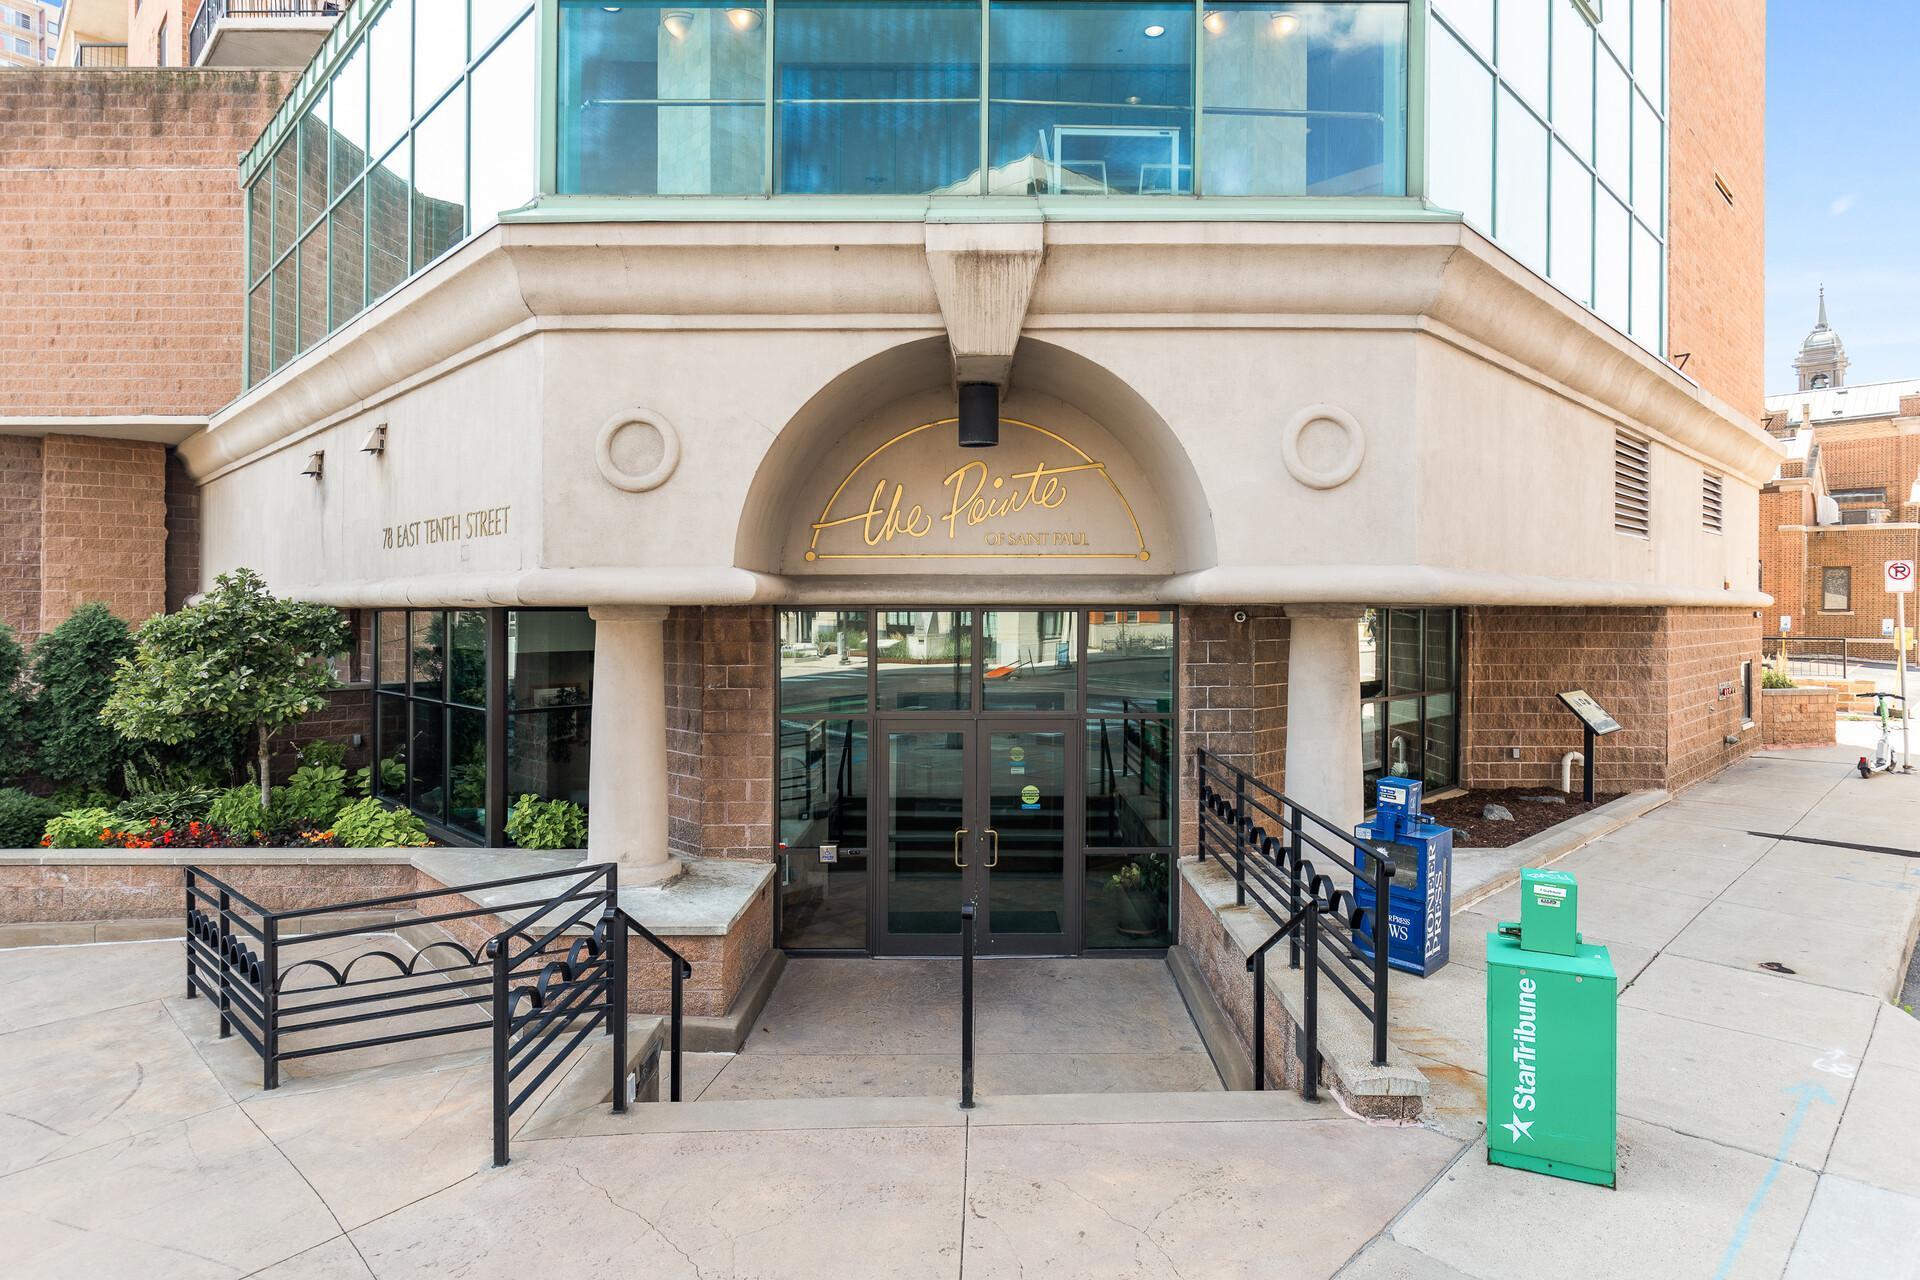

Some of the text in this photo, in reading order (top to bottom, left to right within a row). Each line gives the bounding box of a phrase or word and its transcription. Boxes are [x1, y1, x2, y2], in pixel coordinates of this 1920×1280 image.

[382, 505, 511, 550] 78 EAST TENTH STREET
[811, 460, 1105, 546] the Pointe
[984, 532, 1089, 545] OF SAINT PAUL
[1425, 841, 1436, 960] PIONEER
[1432, 870, 1443, 956] PRESS
[1513, 977, 1537, 1112] StarTribune
